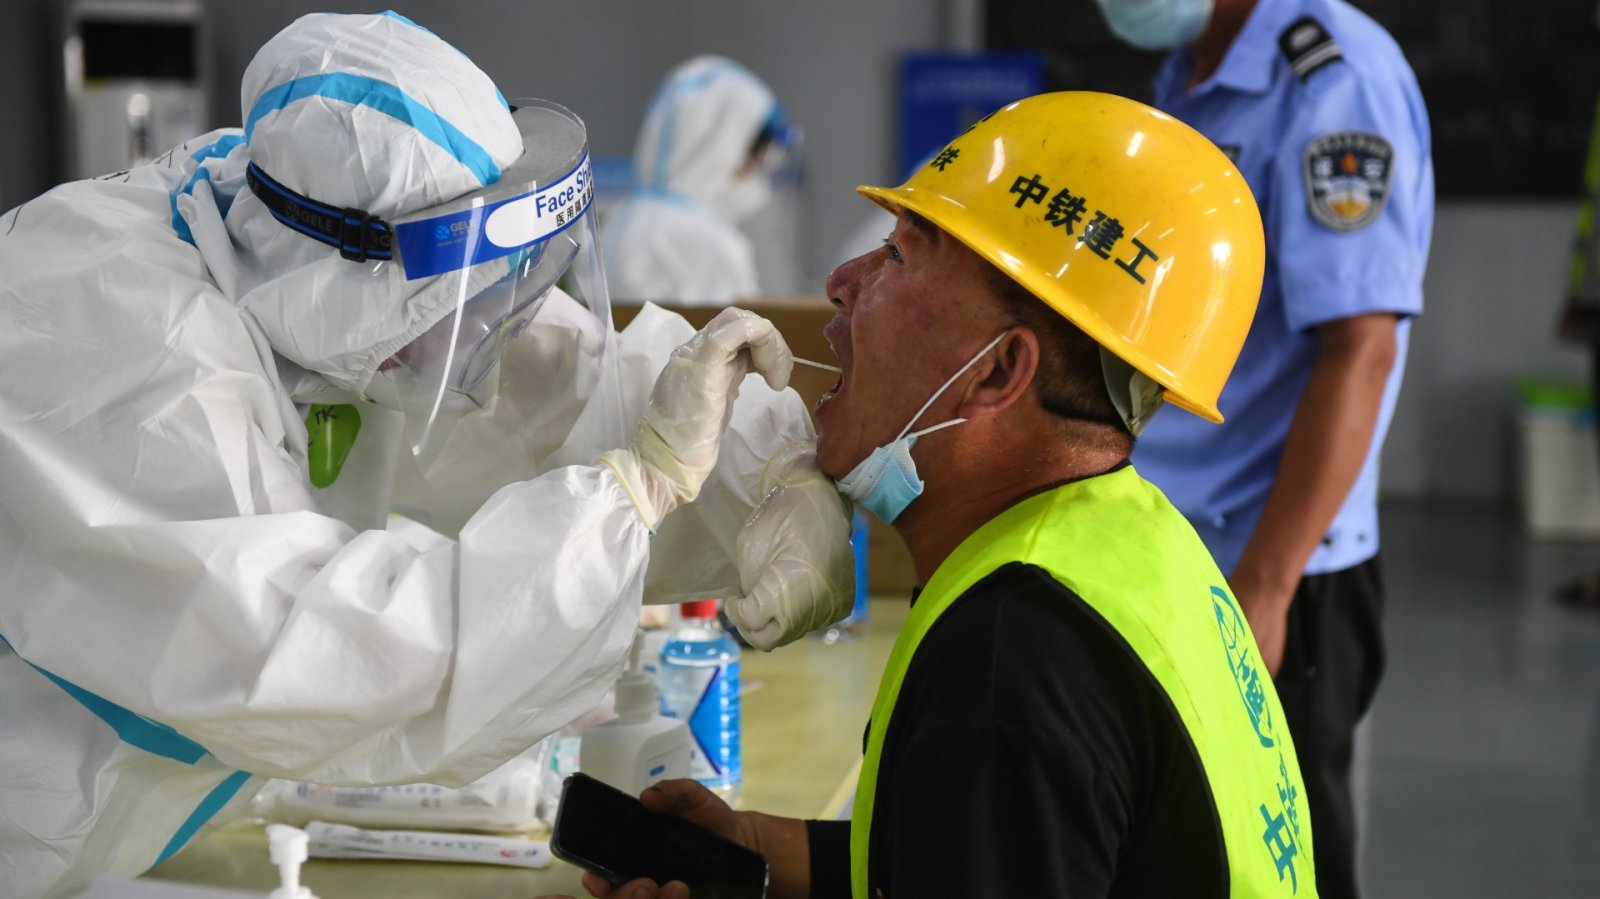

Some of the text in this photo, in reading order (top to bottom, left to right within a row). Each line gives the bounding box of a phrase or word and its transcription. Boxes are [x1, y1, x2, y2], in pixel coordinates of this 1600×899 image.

[536, 186, 574, 218] Face
[302, 209, 333, 232] GELE
[1009, 174, 1160, 285] 中铁建工
